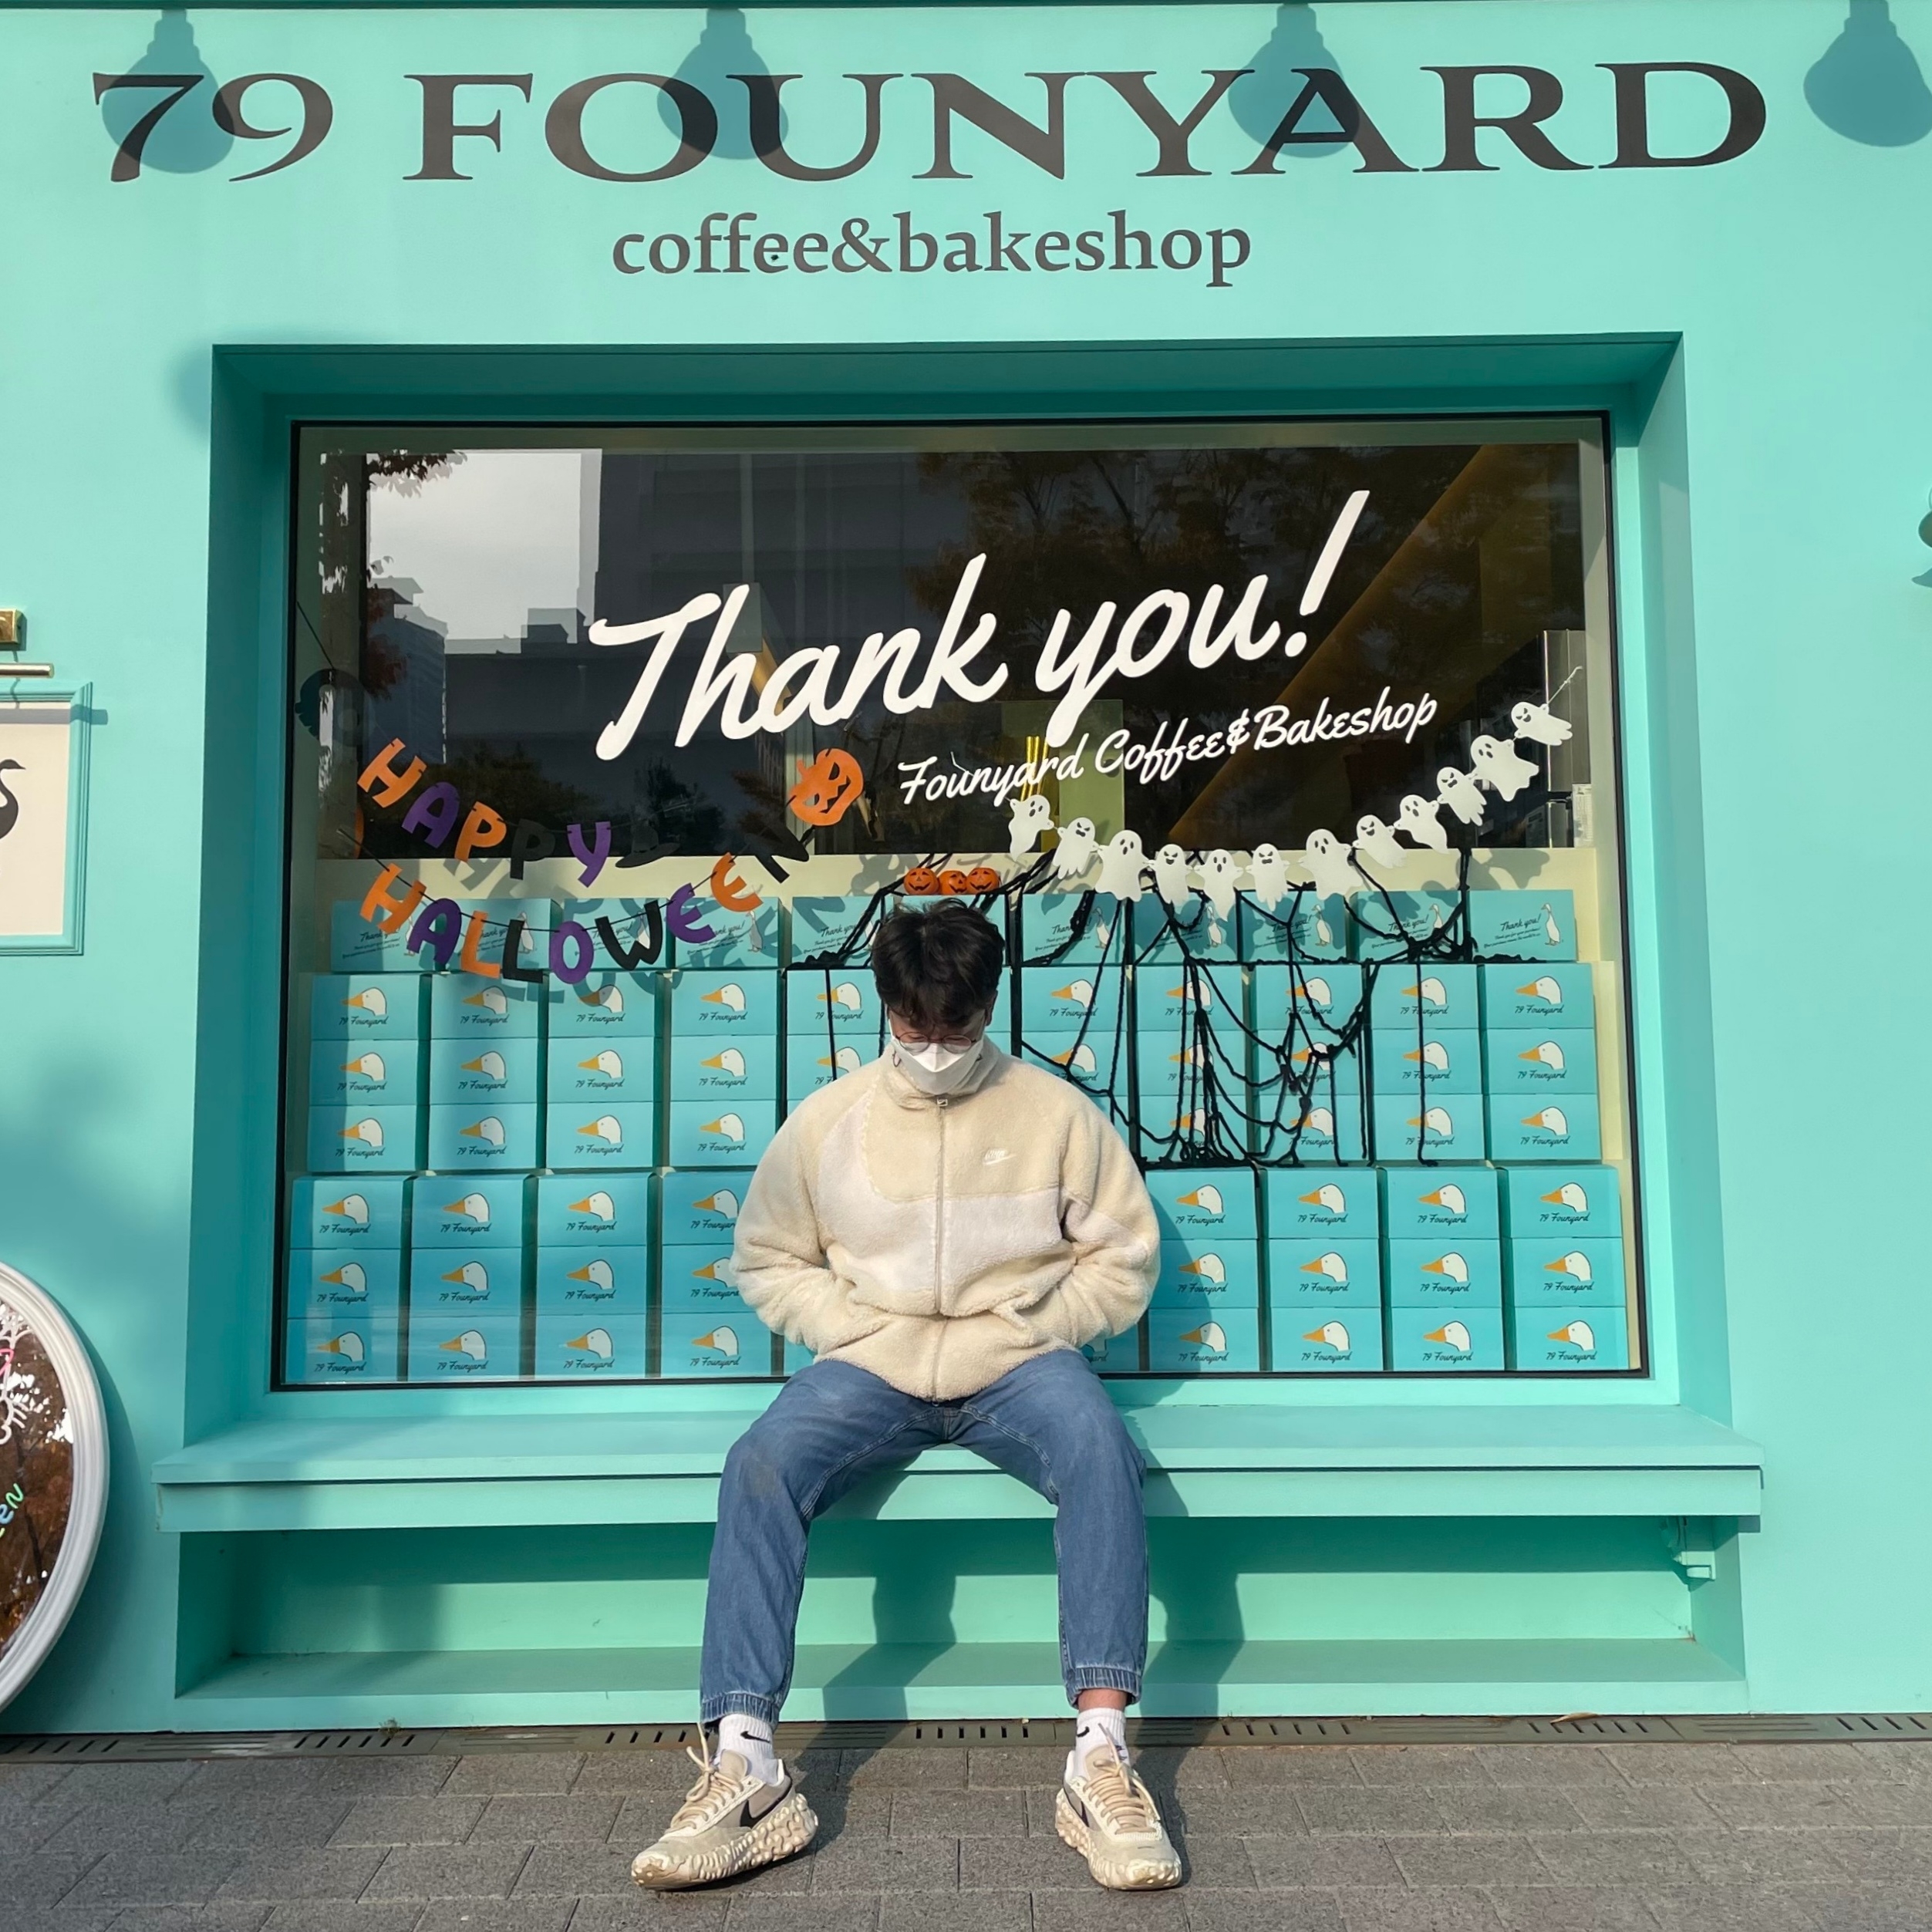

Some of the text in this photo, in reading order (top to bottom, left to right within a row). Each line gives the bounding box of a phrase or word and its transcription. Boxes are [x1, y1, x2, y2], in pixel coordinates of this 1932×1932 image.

[93, 62, 1766, 183] 79 FOUNYARD
[613, 210, 1252, 288] coffee&bakeshop
[588, 490, 1370, 760] Thank you!
[898, 686, 1438, 806] Founyard Coffee&Bakeshop
[1500, 913, 1541, 931] Thank you!
[821, 923, 843, 937] Thank
[1527, 1005, 1564, 1016] Founyard
[351, 1016, 389, 1027] Founyard
[472, 1014, 510, 1027] Founyard
[588, 1013, 625, 1024] Founyard
[711, 1012, 747, 1023] Founyard
[1529, 1070, 1566, 1081] Founyard
[349, 1081, 386, 1093] Founyard
[470, 1080, 507, 1091] Founyard
[588, 1079, 625, 1090] Founyard
[710, 1077, 747, 1088] Founyard
[1532, 1135, 1570, 1147] Founyard
[347, 1148, 385, 1158] Founyard
[469, 1146, 507, 1157] Founyard
[587, 1144, 624, 1156] Founyard
[710, 1142, 746, 1154] Founyard
[690, 1220, 700, 1229] 79
[1187, 1215, 1226, 1226] Founyard
[1310, 1213, 1348, 1226] Founyard
[1430, 1214, 1468, 1226] Founyard
[1552, 1212, 1590, 1225] Founyard
[319, 1224, 371, 1236] 79 Founyard
[453, 1222, 491, 1235] Founyard
[578, 1221, 617, 1233] Founyard
[1190, 1283, 1228, 1295] Founyard
[1311, 1283, 1350, 1294] Founyard
[1432, 1283, 1471, 1295] Founyard
[1556, 1282, 1594, 1293] Founyard
[329, 1293, 369, 1305] Founyard
[451, 1292, 491, 1303] Founyard
[577, 1290, 616, 1302] Founyard
[702, 1357, 740, 1369] Founyard
[1191, 1350, 1229, 1364] Founyard
[1313, 1351, 1352, 1364] Founyard
[1435, 1352, 1473, 1364] Founyard
[1559, 1351, 1597, 1364] Founyard
[327, 1362, 366, 1375] Founyard
[450, 1360, 488, 1373] Founyard
[576, 1359, 615, 1371] Founyard
